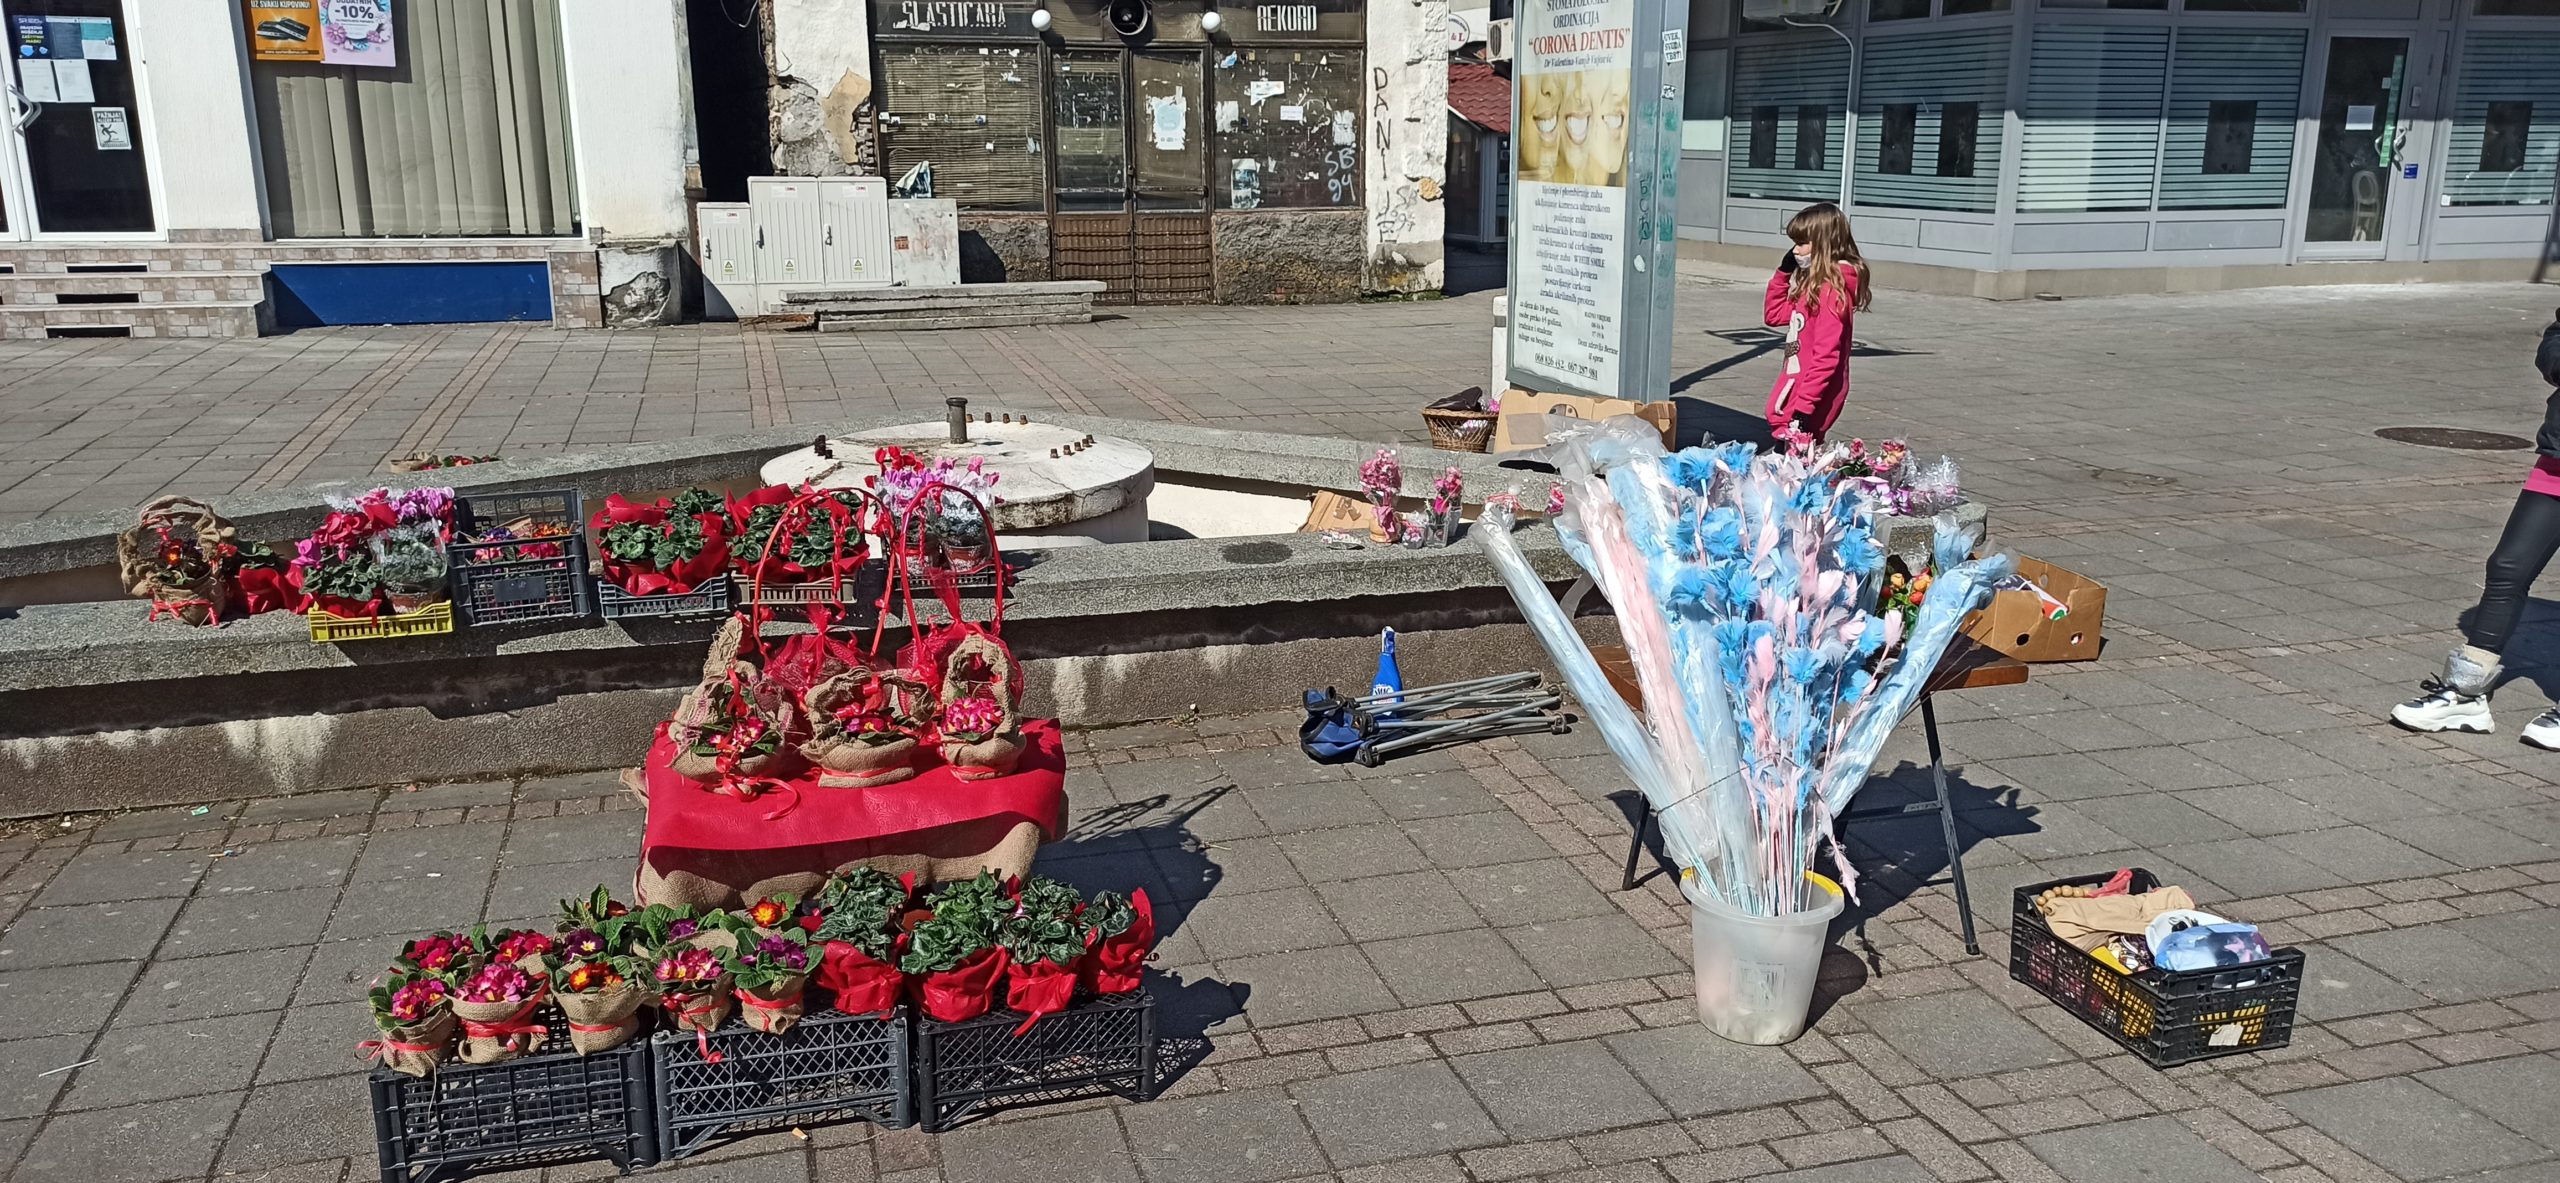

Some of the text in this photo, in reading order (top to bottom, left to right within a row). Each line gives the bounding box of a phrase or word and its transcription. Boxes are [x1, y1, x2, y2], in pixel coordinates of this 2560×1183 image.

[335, 5, 374, 19] -10%
[1257, 5, 1317, 31] REKORD
[1553, 10, 1600, 29] ORDINACIJA
